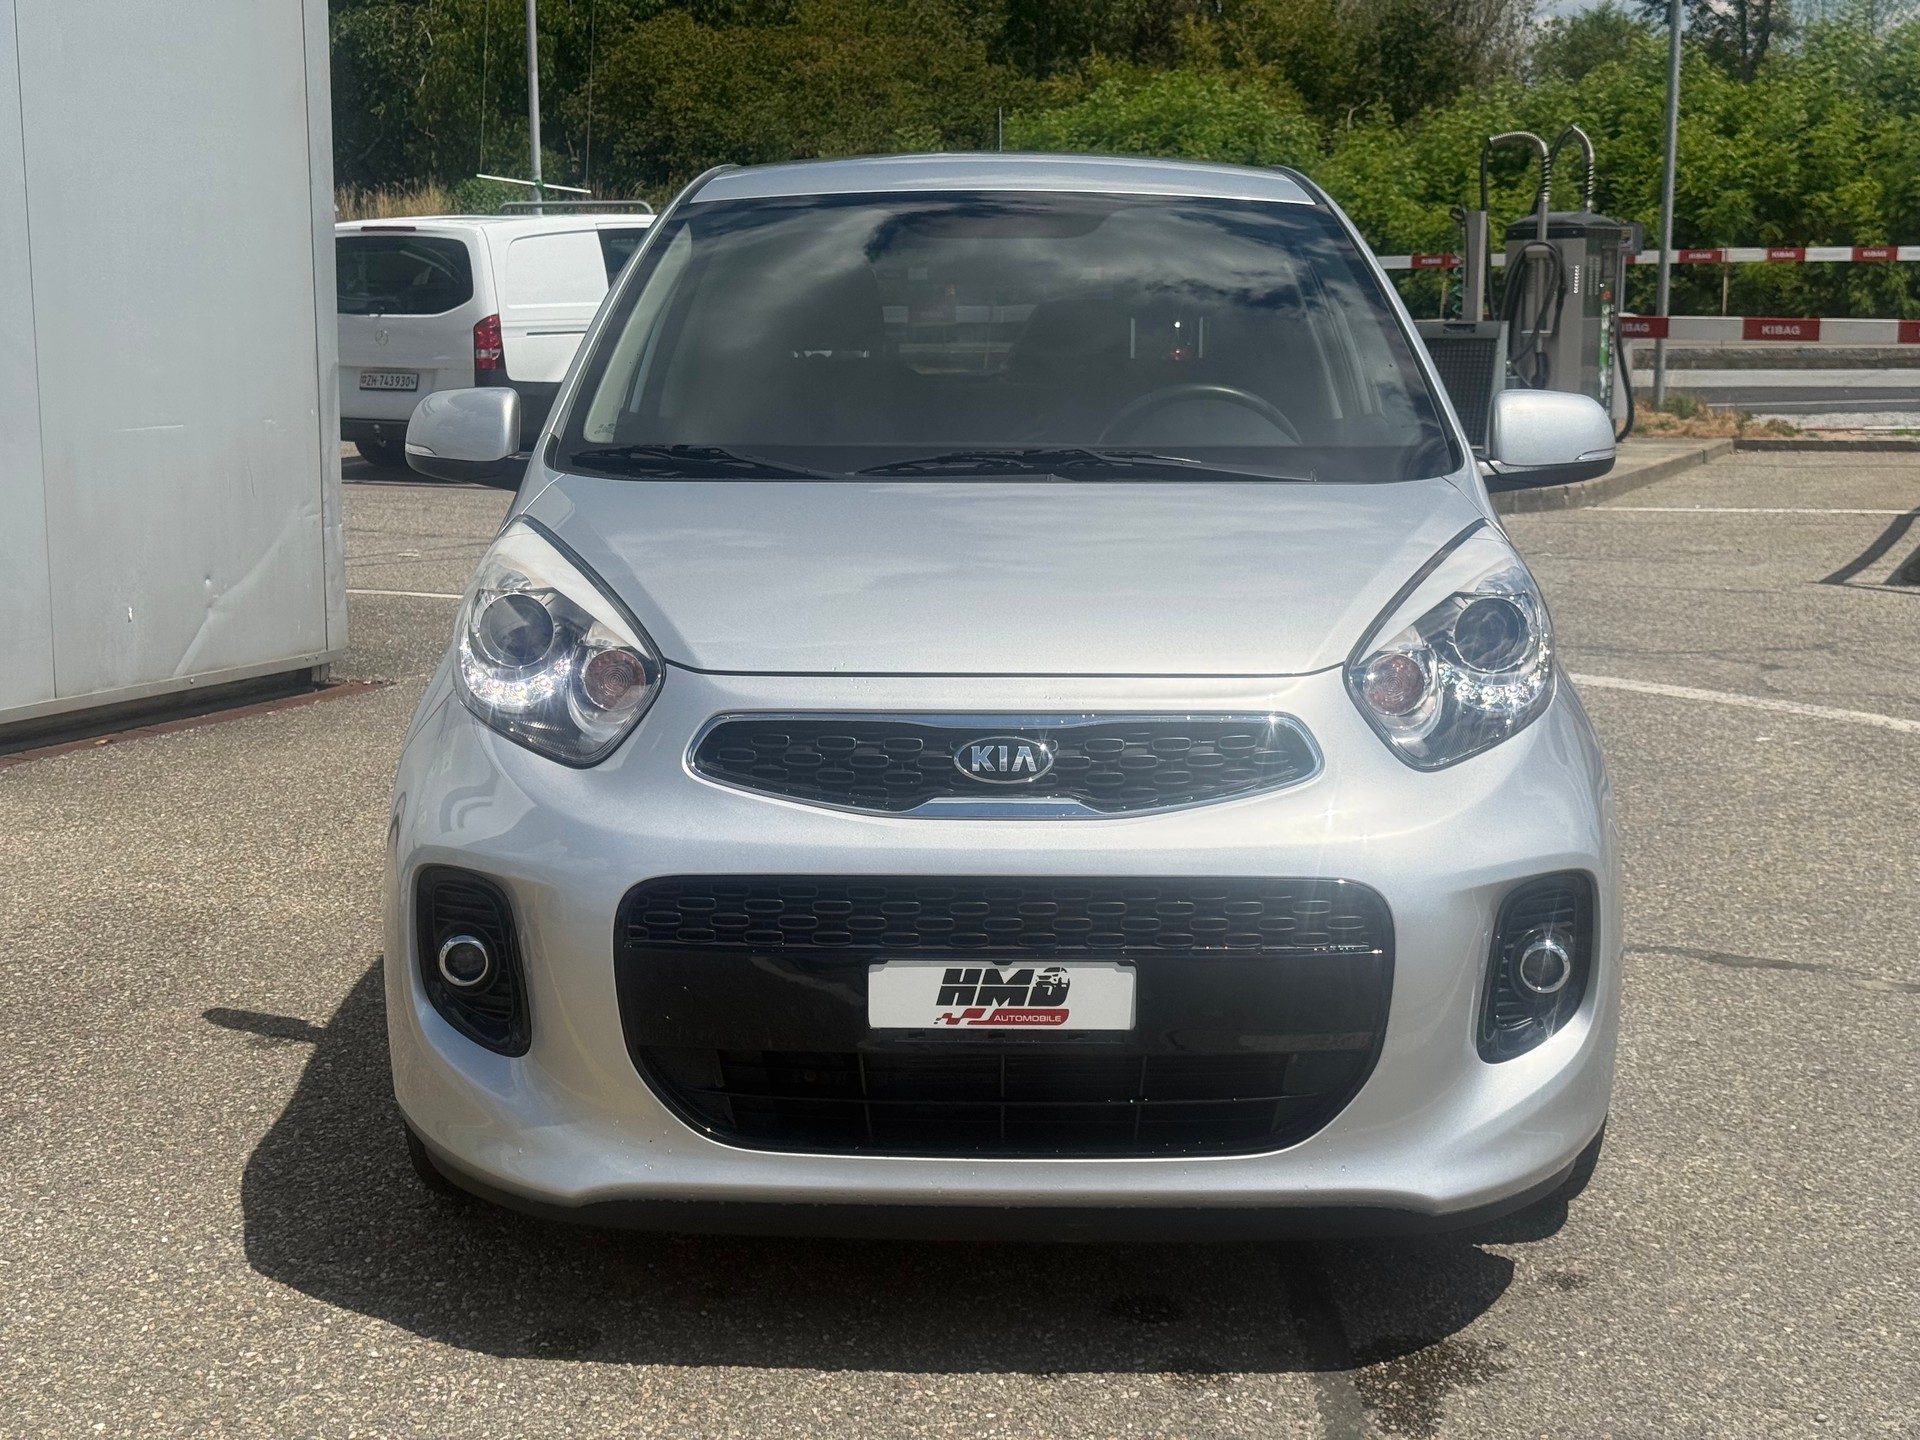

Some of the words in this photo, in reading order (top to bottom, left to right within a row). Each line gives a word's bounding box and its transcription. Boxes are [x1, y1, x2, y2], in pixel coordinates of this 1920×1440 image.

[1621, 322, 1650, 333] IBAG
[1761, 324, 1801, 336] KIBAG
[970, 745, 1038, 772] KIA
[936, 967, 1070, 1007] HMD
[993, 1014, 1062, 1023] AUTOMOBILE
